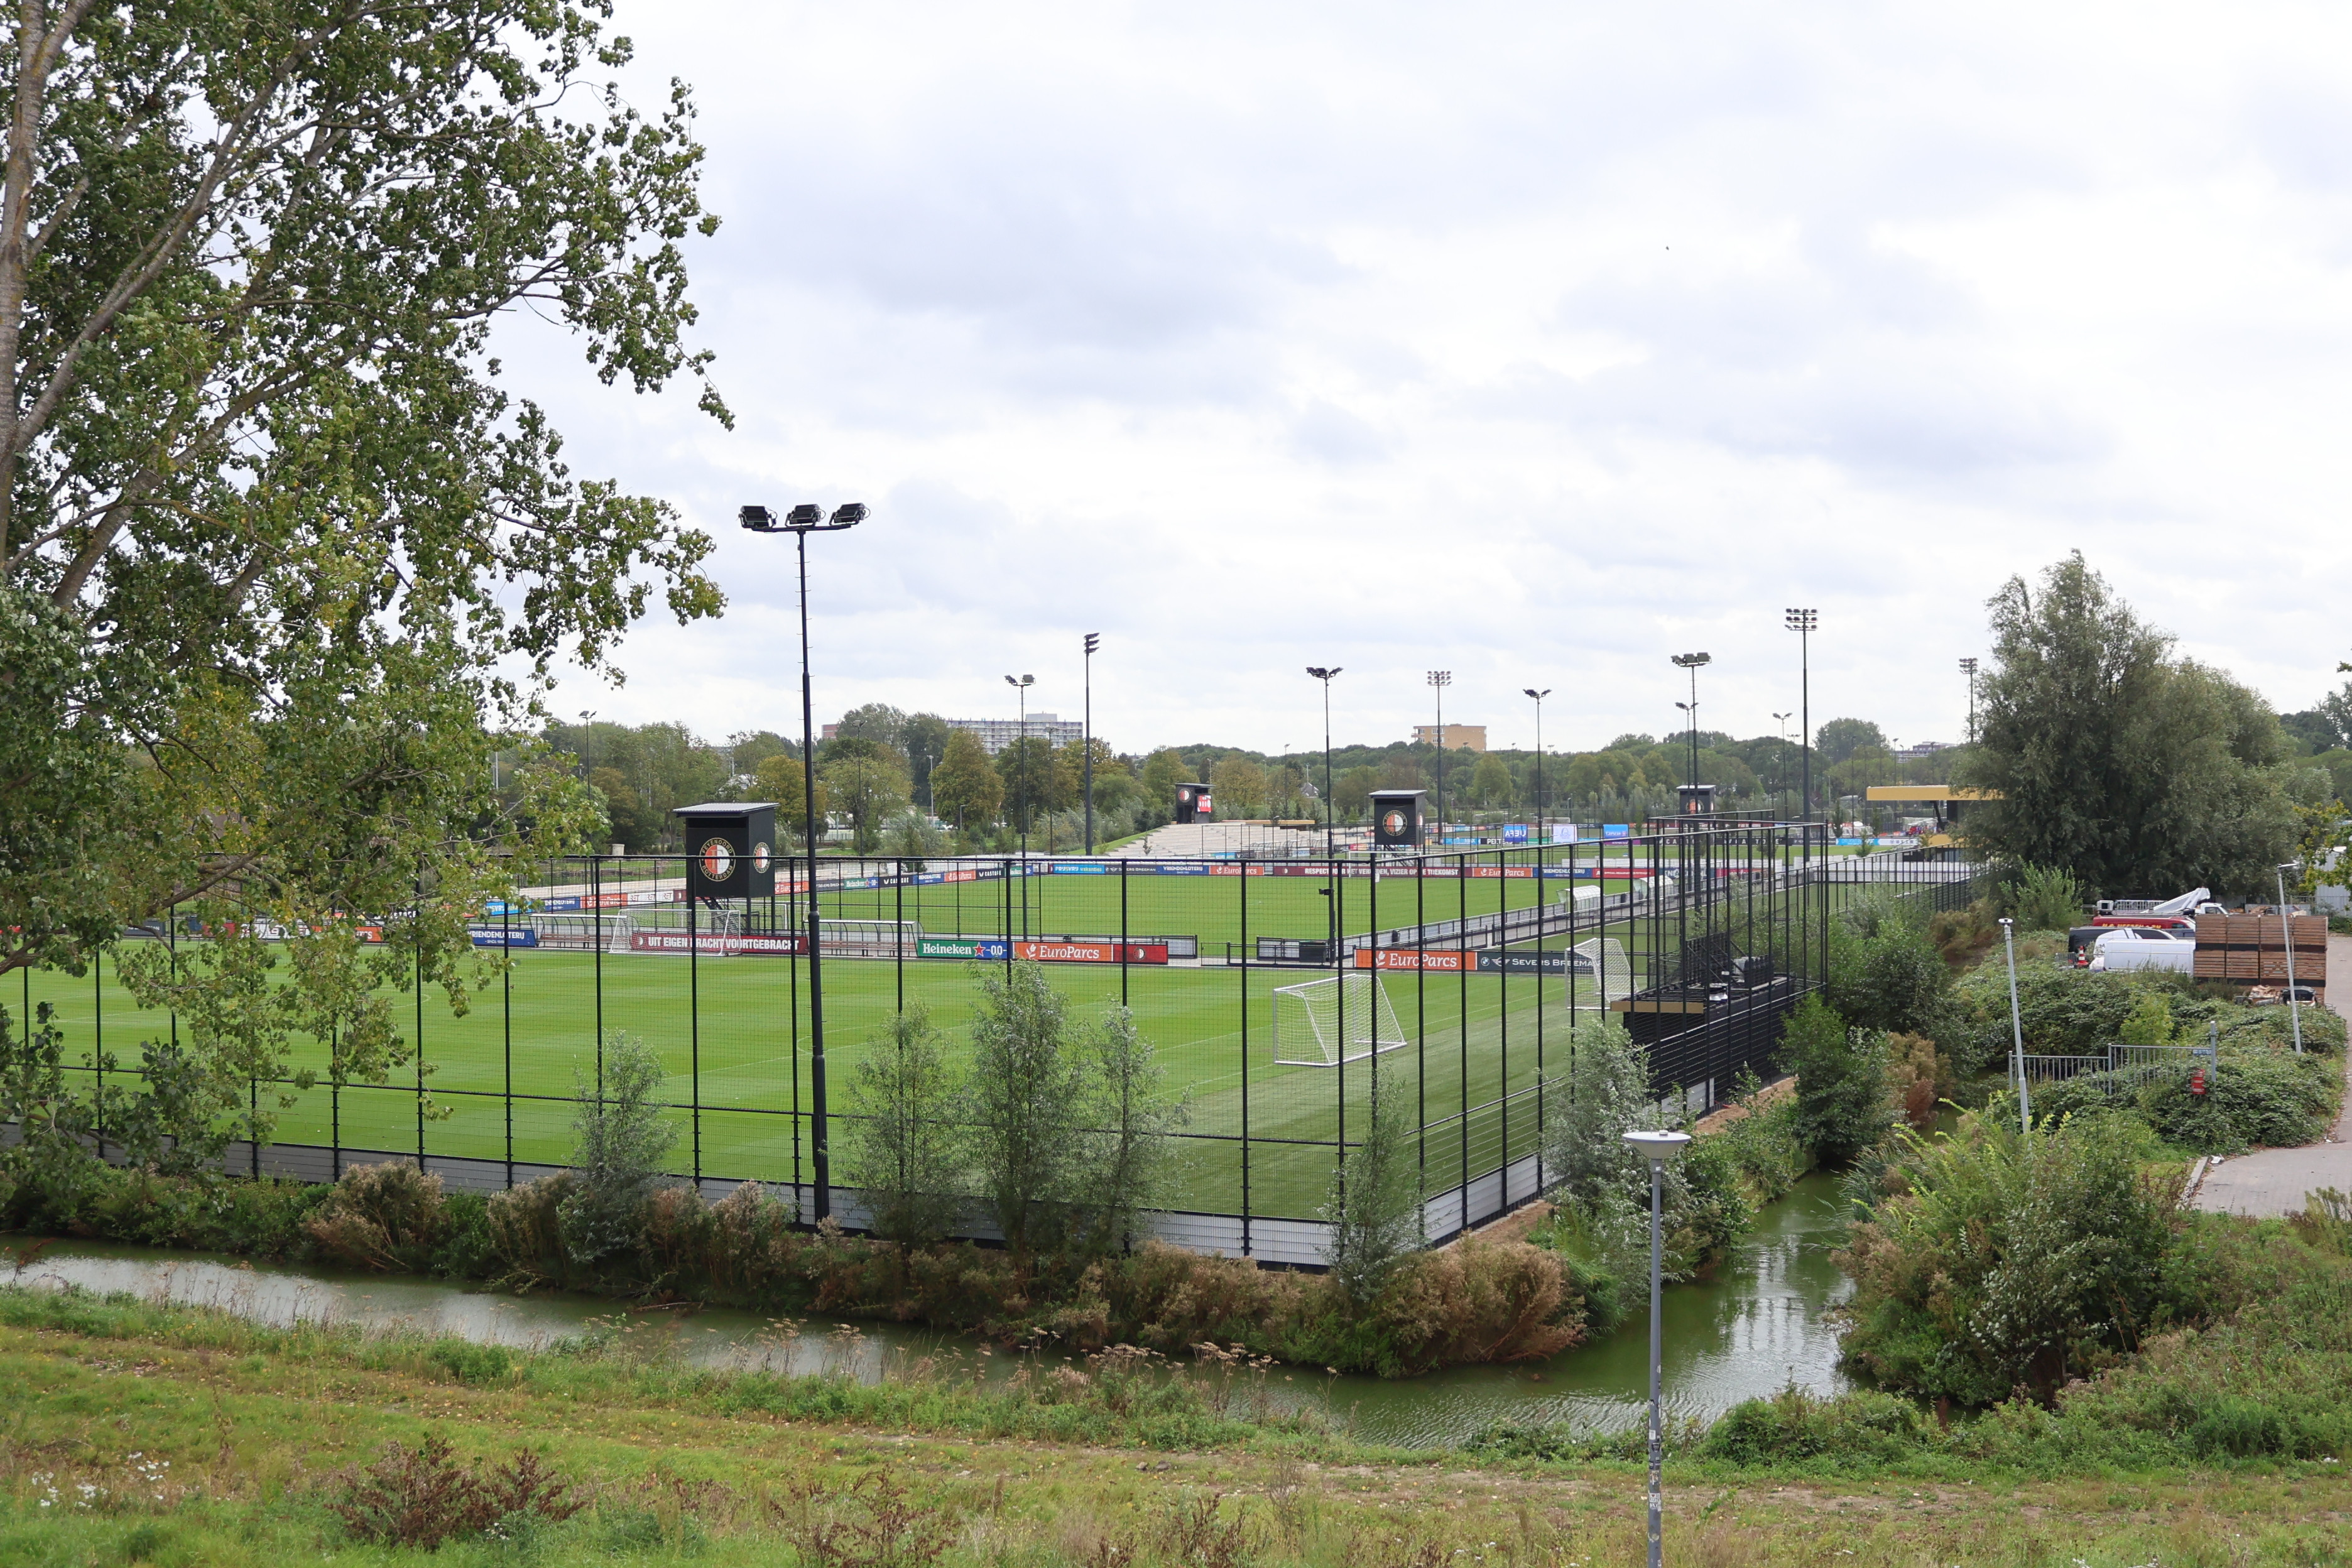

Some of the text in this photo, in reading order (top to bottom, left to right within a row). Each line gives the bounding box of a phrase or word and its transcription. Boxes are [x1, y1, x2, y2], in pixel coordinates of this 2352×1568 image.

[648, 937, 662, 947] UIT
[663, 937, 687, 947] EIGEN
[922, 943, 972, 955] Heineken
[1039, 945, 1099, 959] EuroParcs
